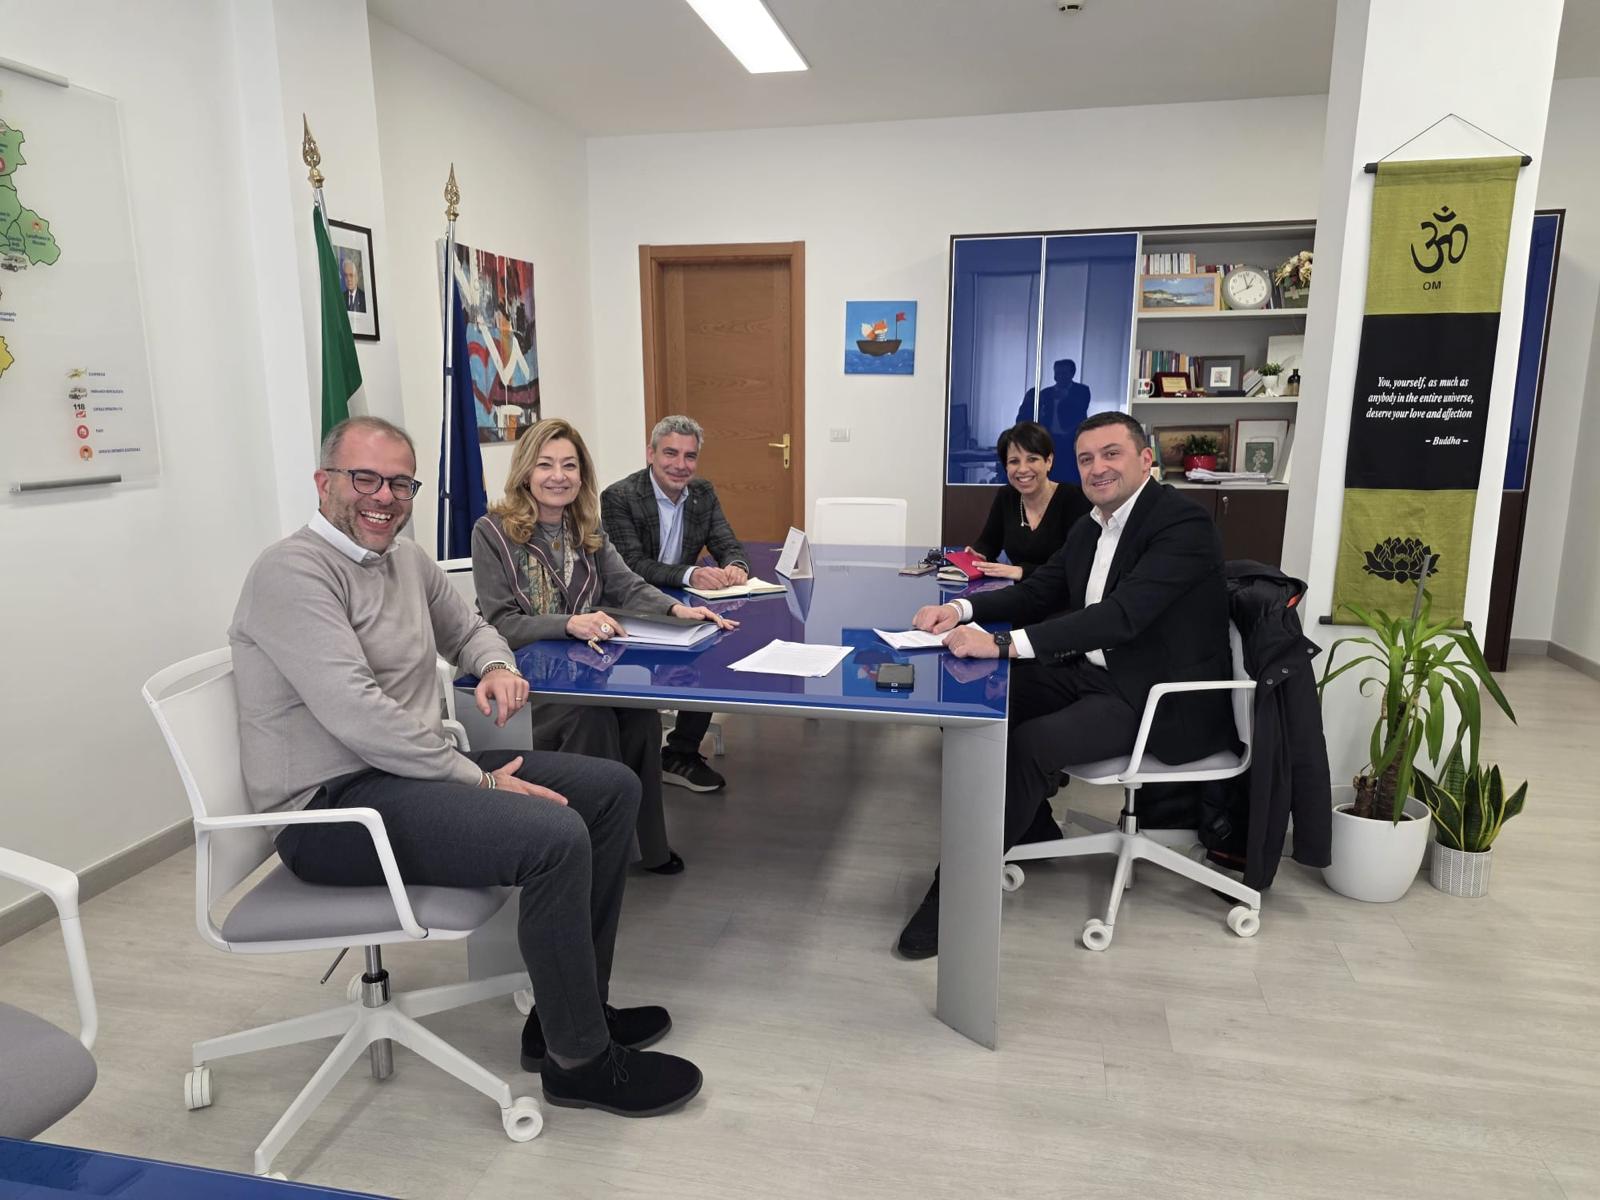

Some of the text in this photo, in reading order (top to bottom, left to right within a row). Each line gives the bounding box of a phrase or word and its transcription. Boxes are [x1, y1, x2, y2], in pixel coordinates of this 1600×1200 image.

[1423, 281, 1442, 291] OM
[1378, 376, 1469, 390] You, yourself, as much as
[1368, 392, 1474, 405] anybody in the entire universe,
[1366, 407, 1473, 420] deserve your love and affection
[1432, 436, 1461, 445] Buddha
